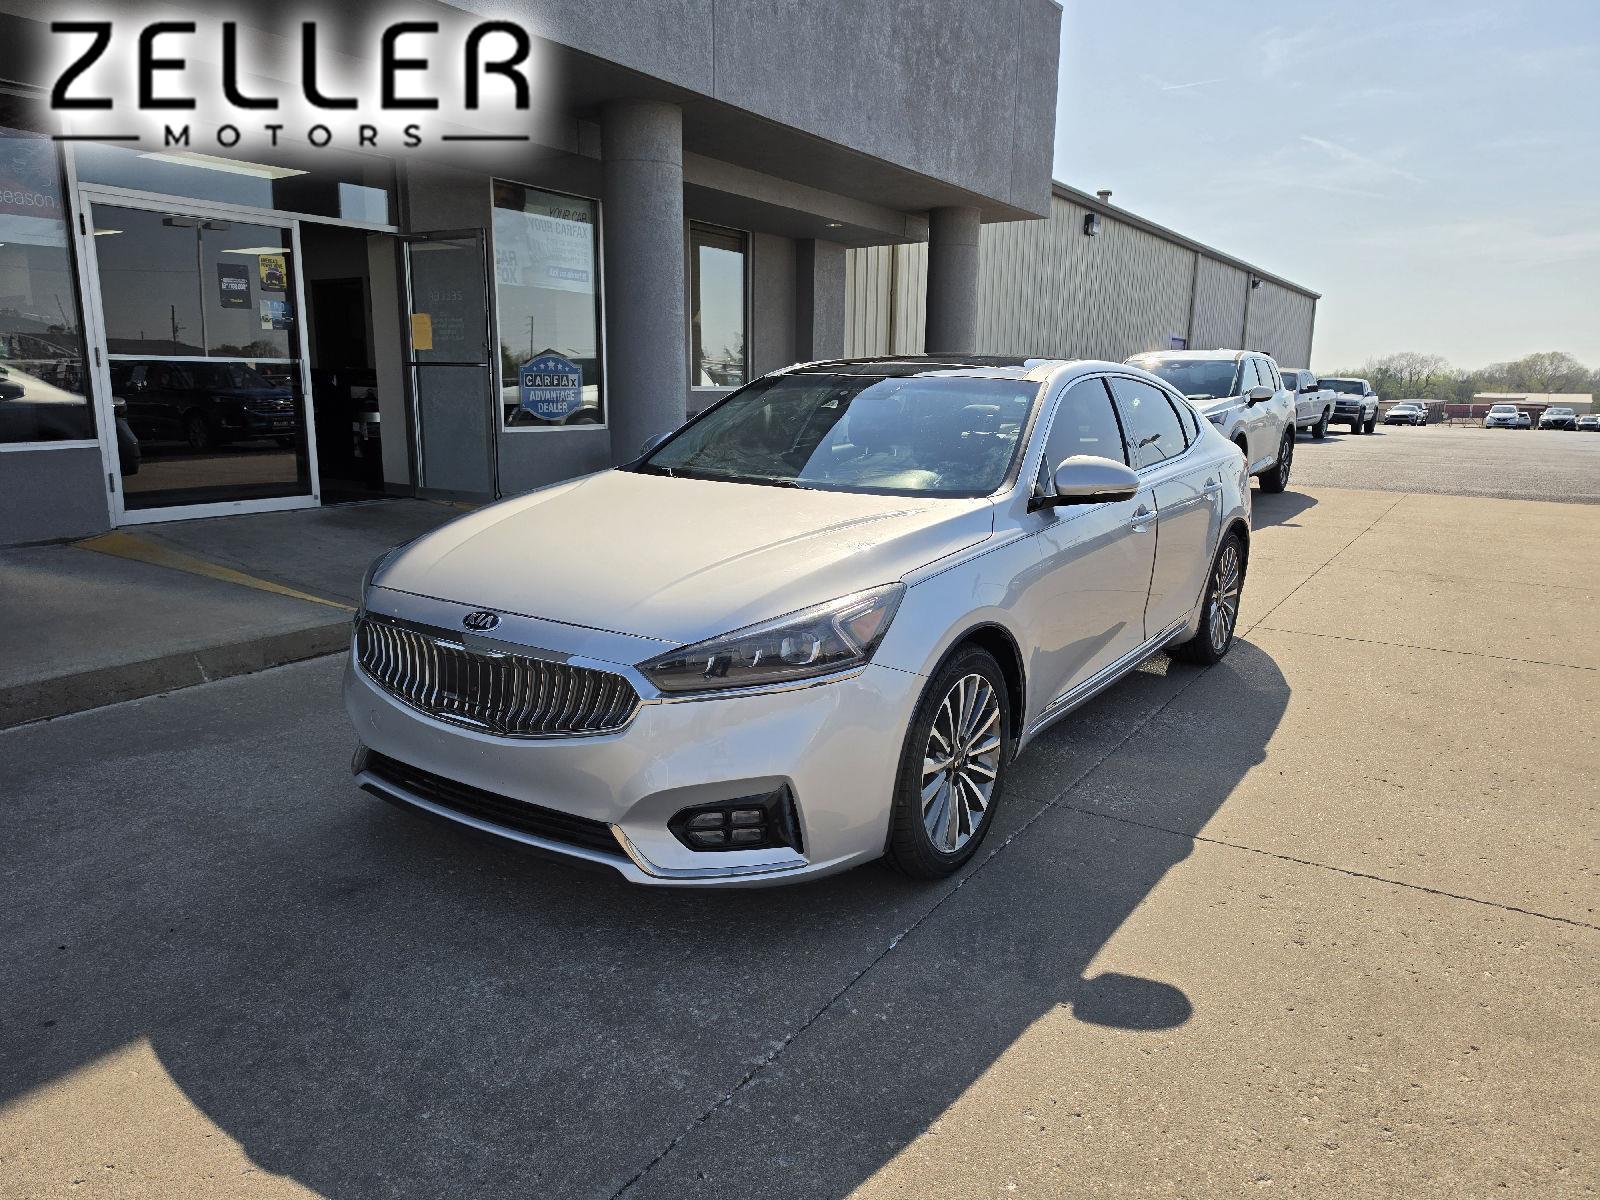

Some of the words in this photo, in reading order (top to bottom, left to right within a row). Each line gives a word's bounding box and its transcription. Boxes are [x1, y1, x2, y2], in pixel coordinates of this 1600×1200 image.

[527, 217, 553, 233] YOUR
[555, 222, 588, 239] CARFAX
[525, 374, 577, 388] CARFAX
[529, 390, 575, 401] ADVANTAGE
[538, 402, 568, 413] DEALER
[466, 612, 494, 628] KIA
